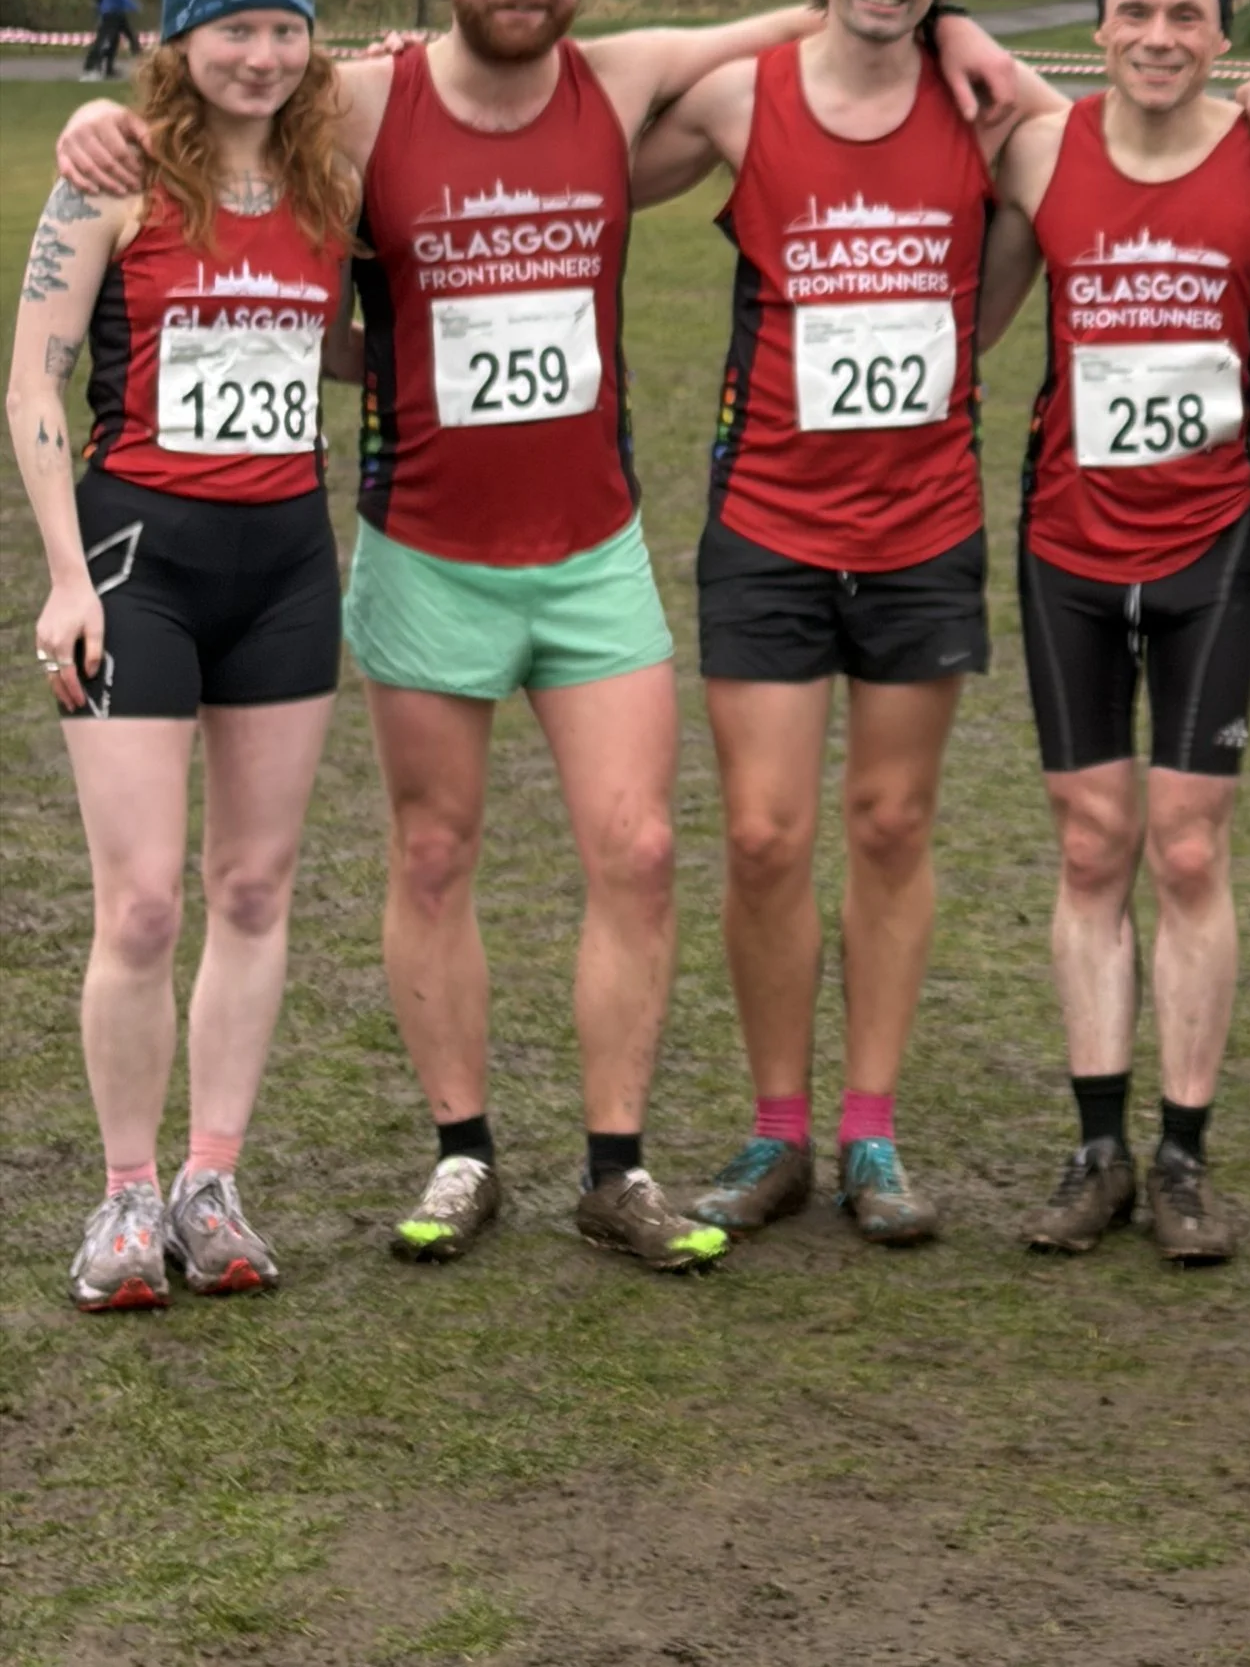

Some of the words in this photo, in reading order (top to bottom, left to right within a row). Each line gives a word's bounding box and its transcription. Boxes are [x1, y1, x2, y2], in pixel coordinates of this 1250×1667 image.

[413, 219, 604, 263] GLASGOW
[785, 237, 952, 272] GLASGOW
[419, 257, 602, 291] FRONTRUNNERS
[787, 271, 949, 301] FRONTRUNNERS
[1069, 273, 1228, 305] GLASGOW
[1072, 306, 1224, 332] FRONTRUNNERS
[469, 345, 570, 413] 259
[831, 353, 929, 417] 262
[181, 379, 307, 441] 1238
[1108, 393, 1208, 454] 258
